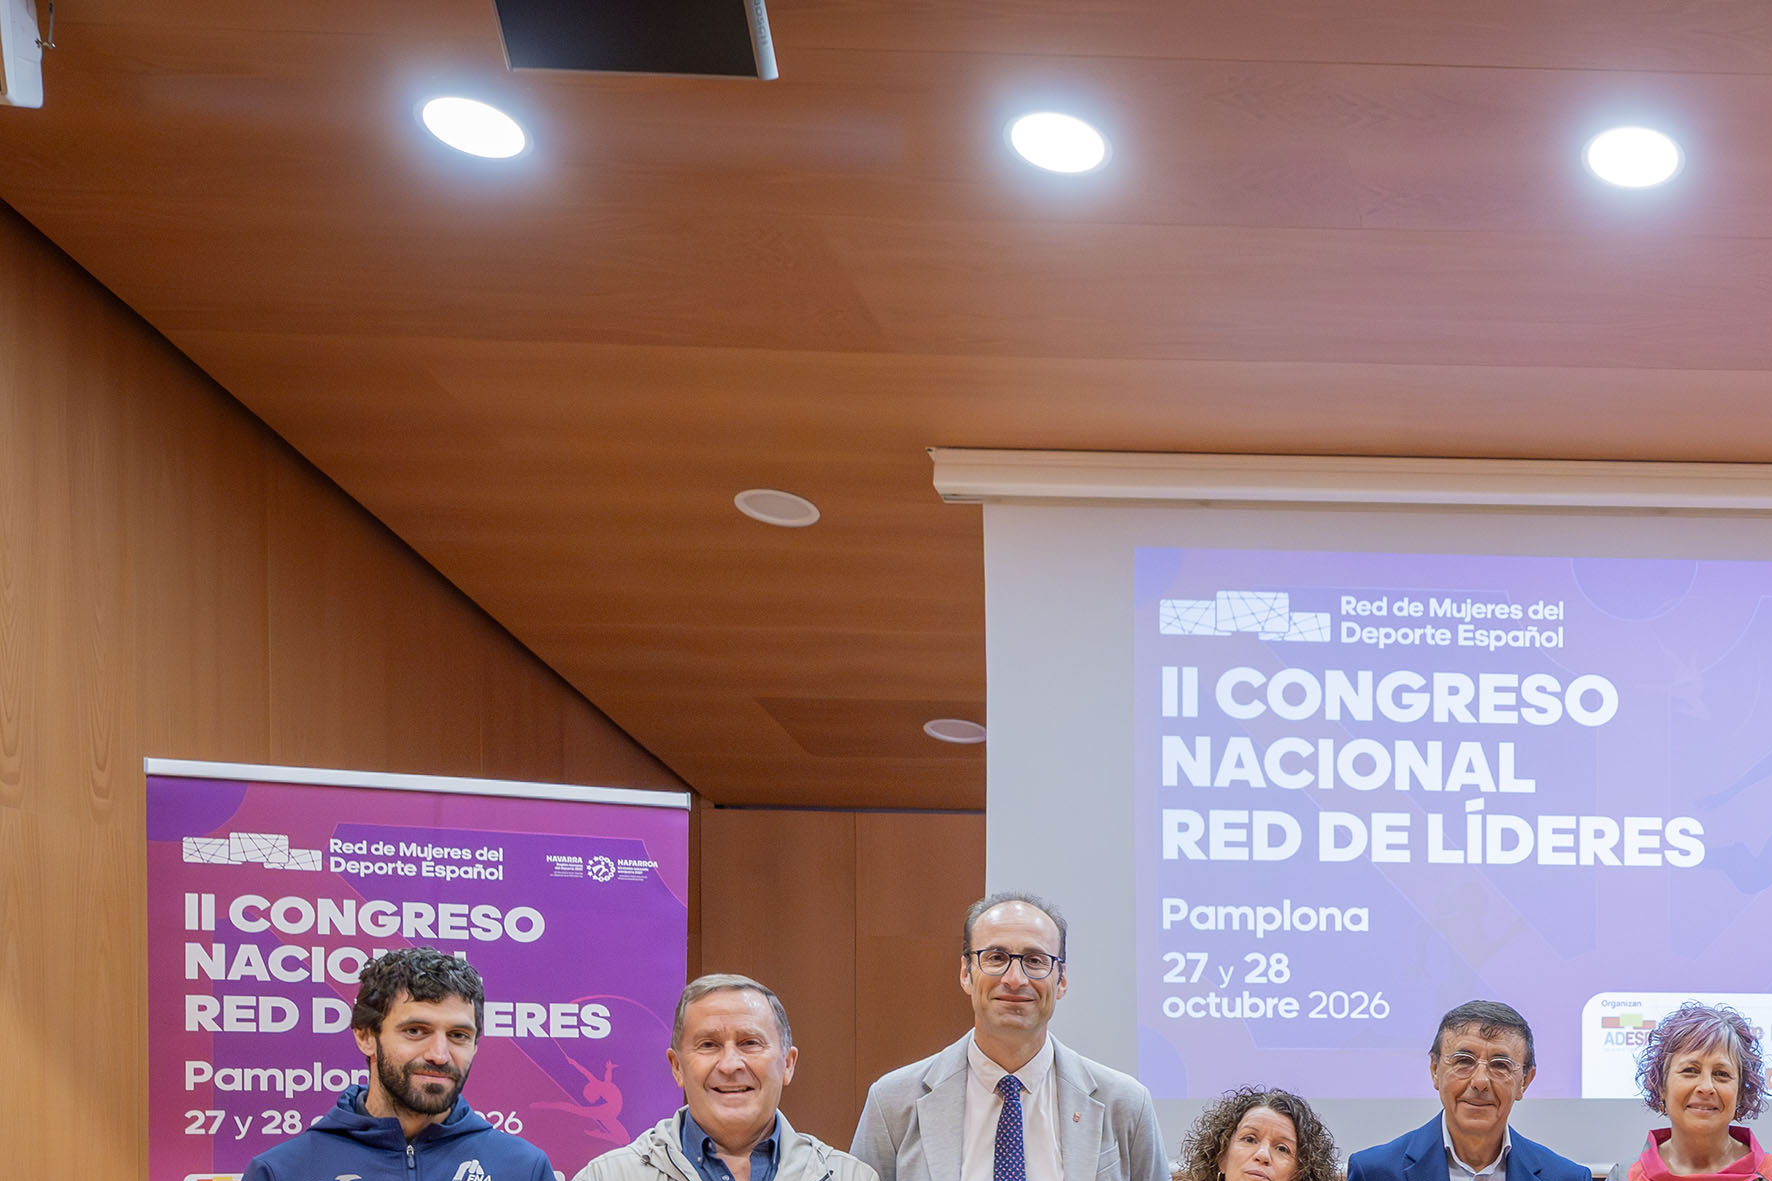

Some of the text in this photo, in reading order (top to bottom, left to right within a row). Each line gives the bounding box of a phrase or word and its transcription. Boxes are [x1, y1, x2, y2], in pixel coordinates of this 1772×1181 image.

[1341, 596, 1563, 621] Red de Mujeres del
[1341, 622, 1563, 651] Deporte Español
[1162, 667, 1618, 726] II CONGRESO
[1163, 736, 1535, 792] NACIONAL
[1163, 798, 1705, 867] RED DE LÍDERES
[330, 839, 503, 861] Red de Mujeres del
[546, 855, 583, 863] NAVARRA
[618, 859, 658, 868] NAFARROA
[330, 857, 503, 880] Deporte Español
[185, 893, 546, 943] II CONGRESO
[1163, 898, 1368, 938] Pamplona
[1163, 952, 1290, 989] 27 y 28
[186, 995, 611, 1038] RED D ERES
[1163, 989, 1389, 1019] octubre 2026
[1601, 1000, 1642, 1009] Organizan
[186, 1061, 370, 1098] Pamplon
[185, 1110, 225, 1134] 27
[234, 1116, 252, 1139] y
[262, 1110, 302, 1134] 28
